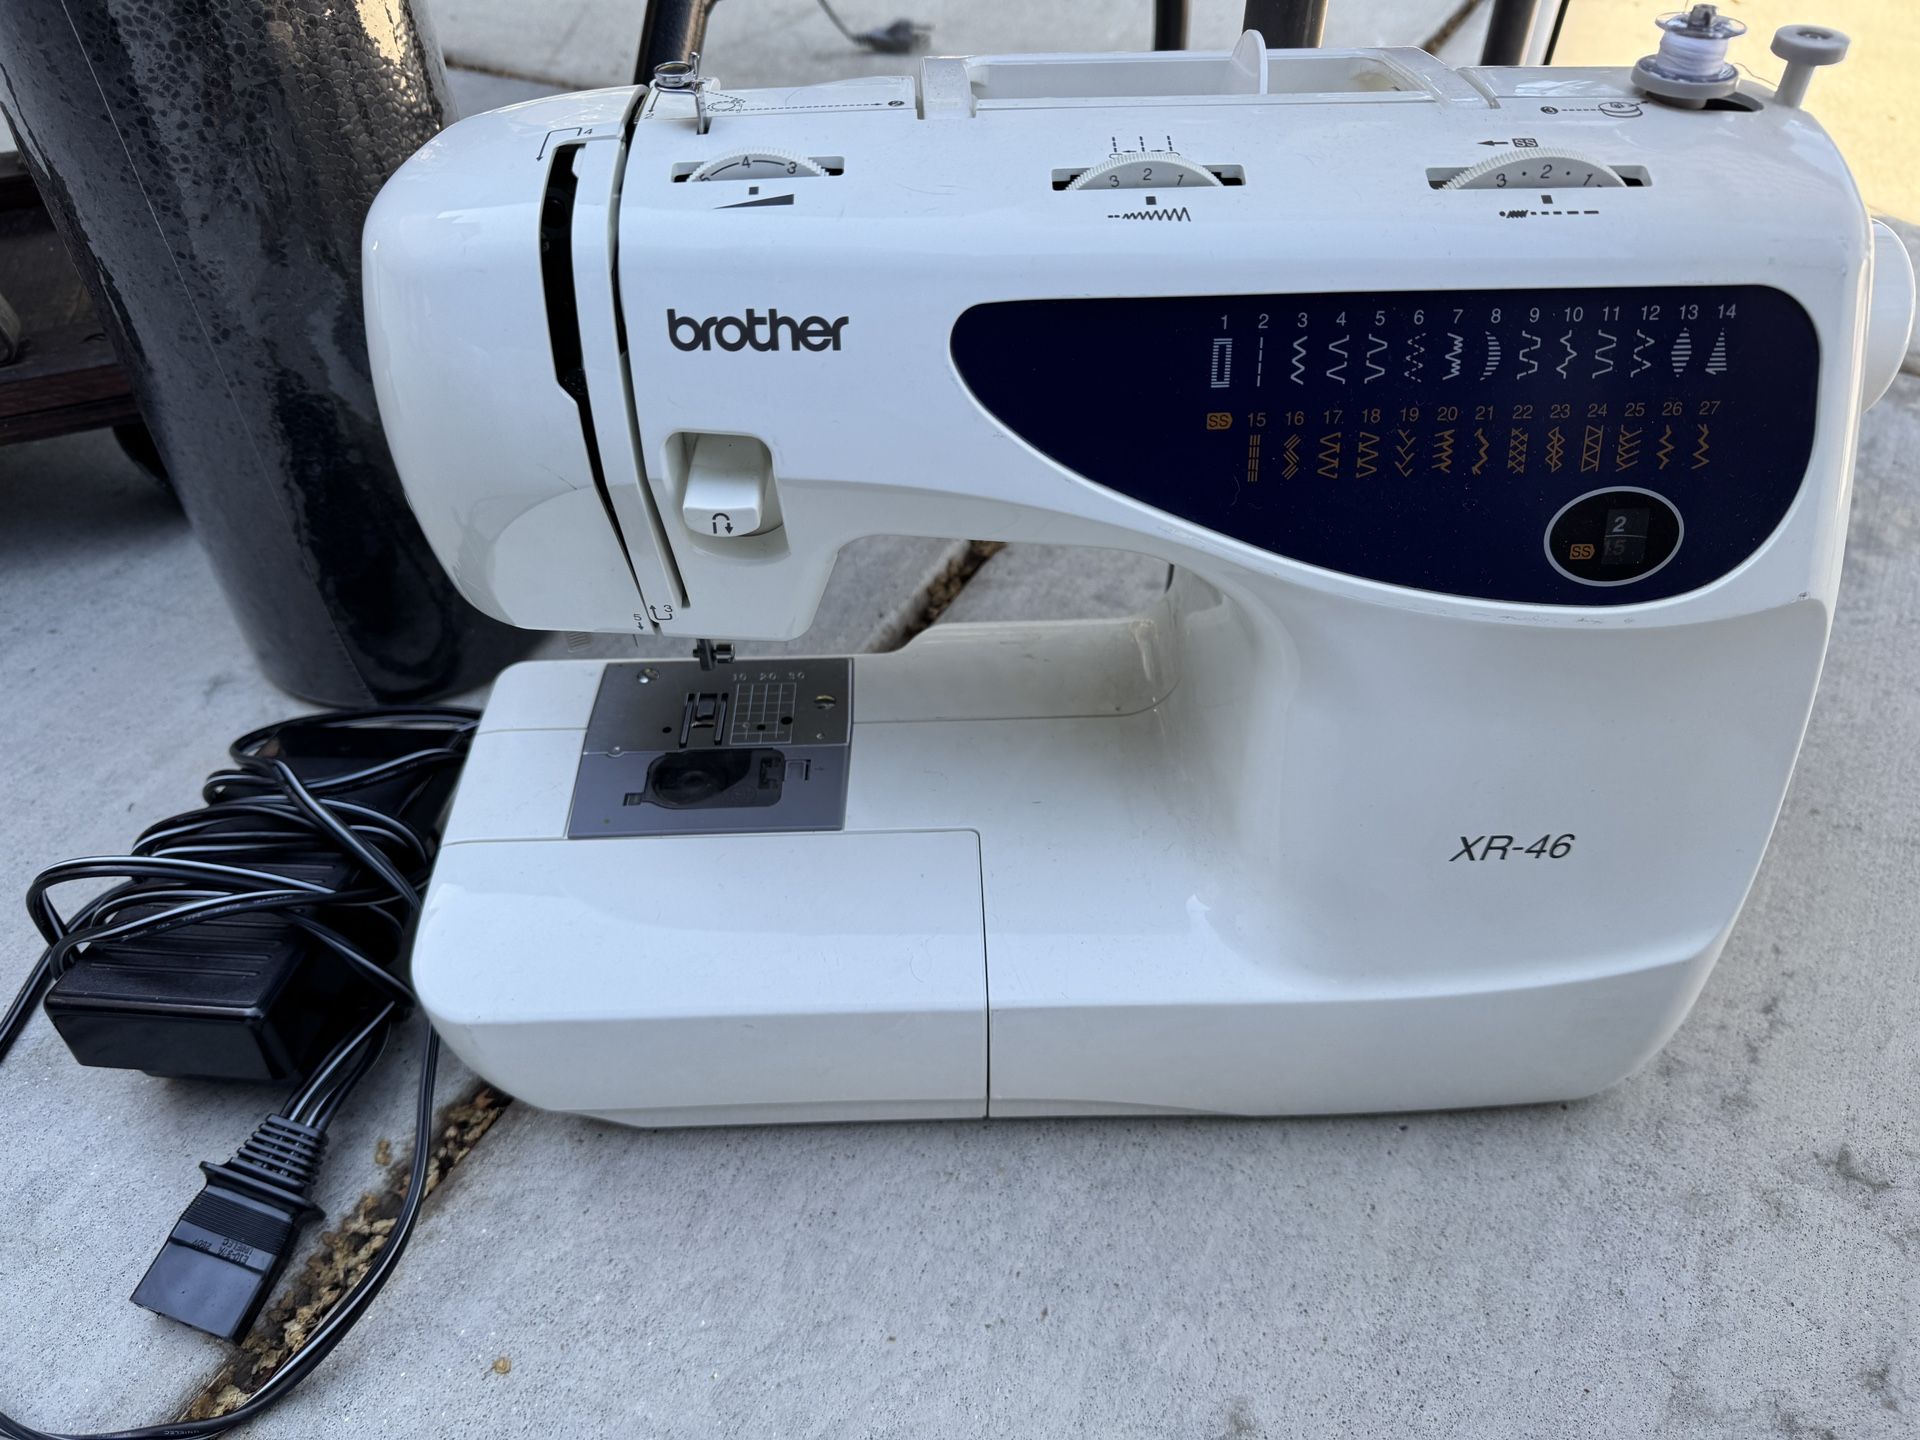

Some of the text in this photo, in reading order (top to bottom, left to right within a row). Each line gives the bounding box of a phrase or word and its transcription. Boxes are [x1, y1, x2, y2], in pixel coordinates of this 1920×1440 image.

[1513, 138, 1538, 148] SS
[741, 155, 751, 169] 4
[786, 161, 798, 175] 3
[1109, 168, 1185, 188] 3 2 1
[1496, 164, 1594, 188] 3 2 1
[1220, 304, 1737, 330] 1 2 3 4 5 6 7 8 9 10 11 12 13 14
[666, 308, 849, 352] brother
[1207, 400, 1721, 429] SS 15 16 17 18 19 20 21 22 23 24 25 26 27
[1612, 515, 1627, 533] 2
[1571, 545, 1593, 559] SS
[633, 613, 642, 621] 5
[663, 604, 673, 613] 3
[1448, 833, 1576, 862] XR-46
